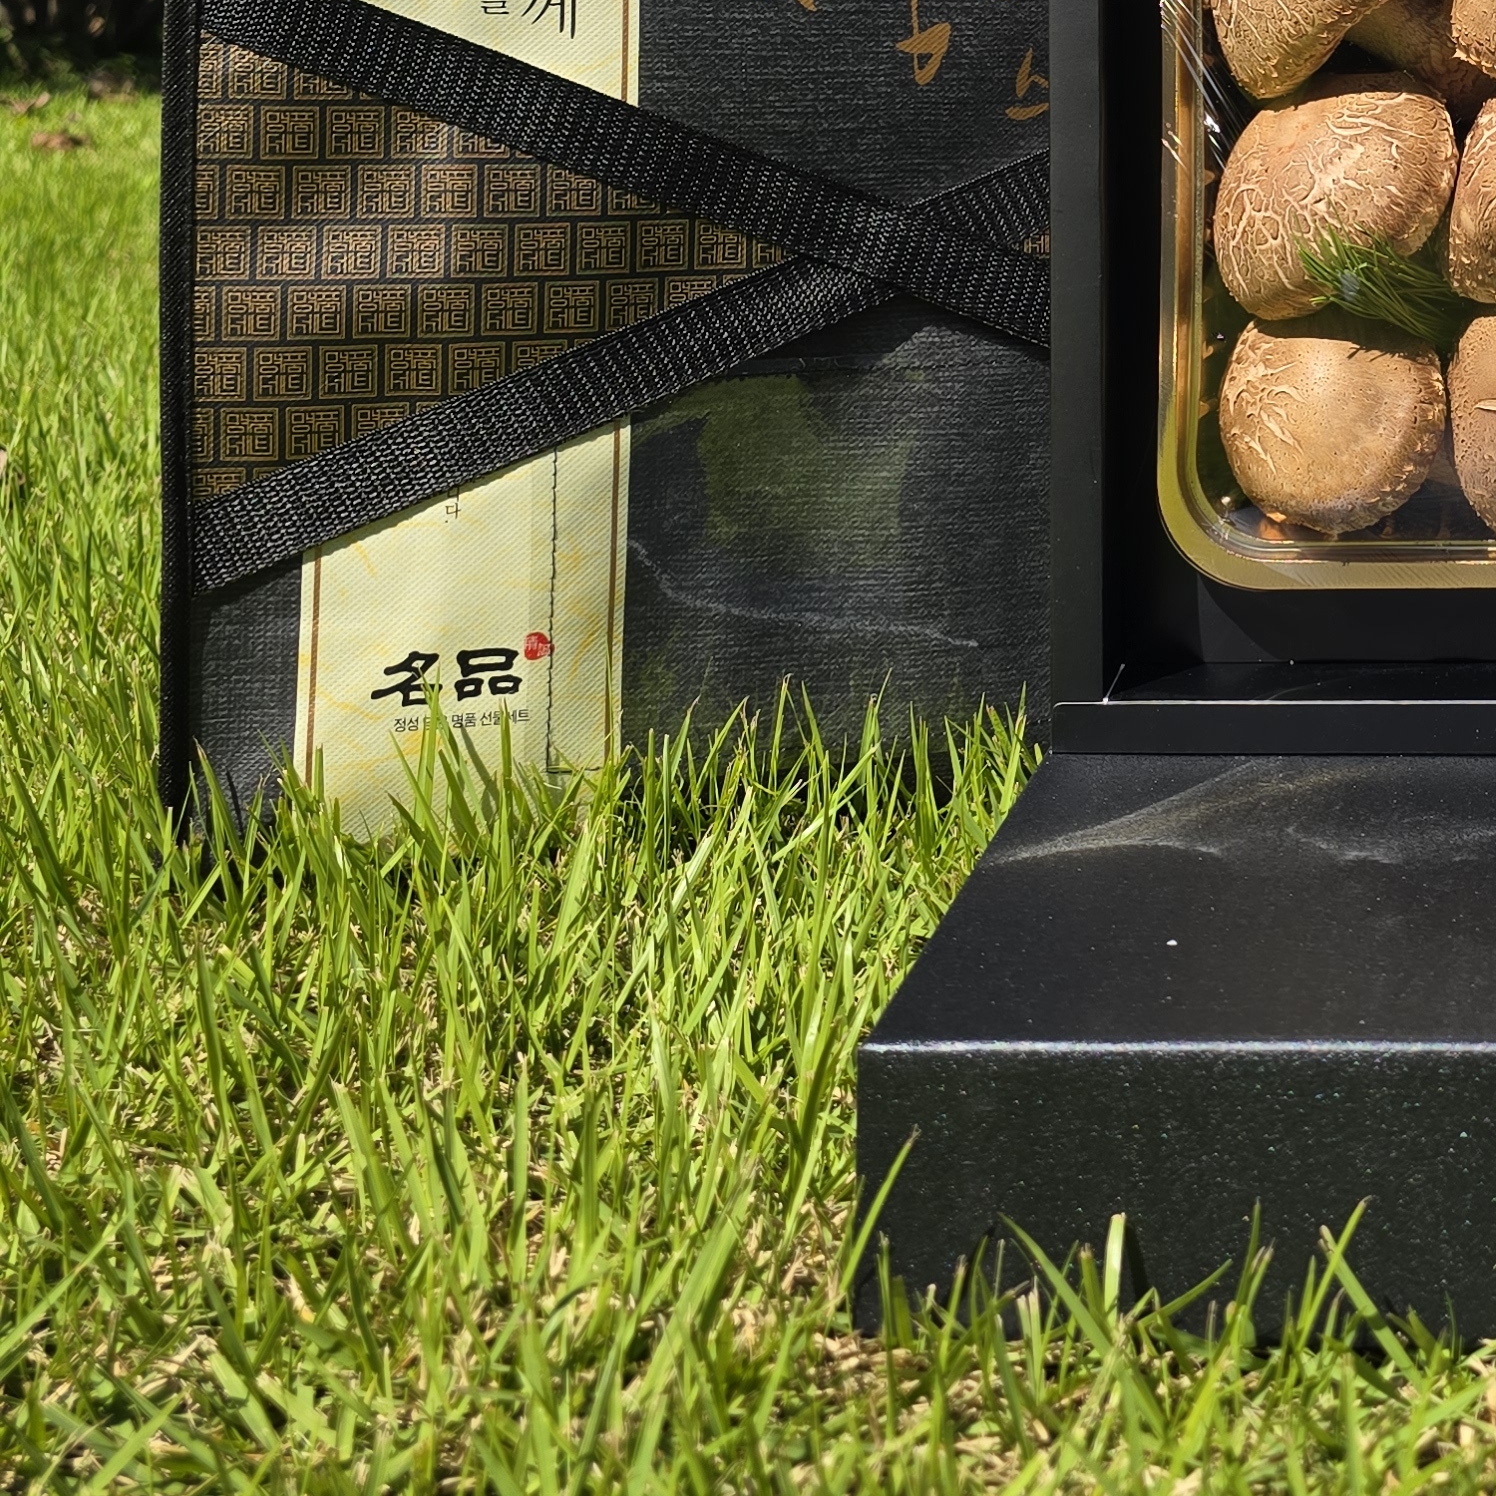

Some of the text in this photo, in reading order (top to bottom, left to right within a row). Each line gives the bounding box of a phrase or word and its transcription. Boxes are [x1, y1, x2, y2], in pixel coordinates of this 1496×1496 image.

[370, 647, 523, 707] 名品
[394, 716, 420, 733] 정성
[451, 712, 478, 729] 명품
